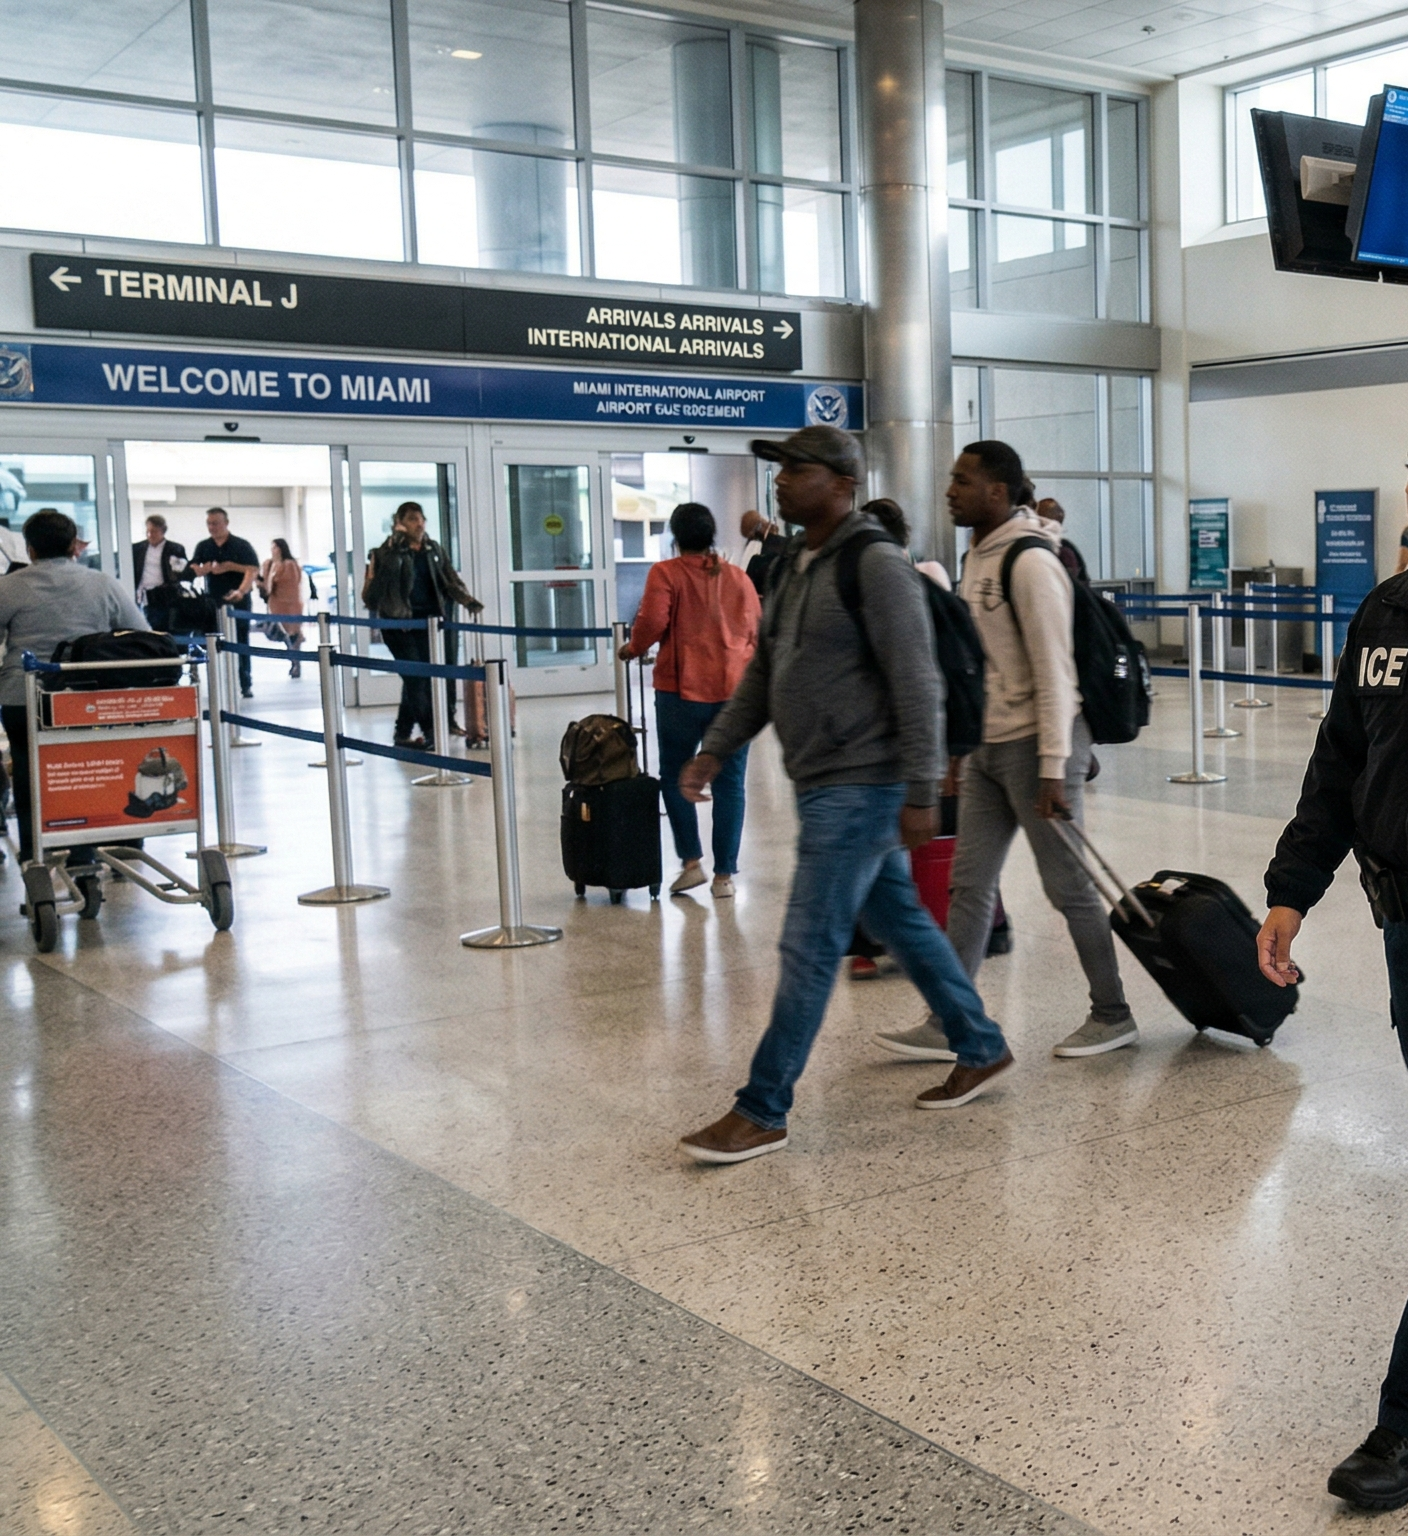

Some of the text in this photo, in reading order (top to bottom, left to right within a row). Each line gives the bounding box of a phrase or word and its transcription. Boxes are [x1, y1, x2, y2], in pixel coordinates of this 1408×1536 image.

[96, 268, 298, 309] TERMINAL J
[586, 307, 764, 336] ARRIVALS ARRIVALS
[528, 328, 764, 359] INTERNATIONAL ARRIVALS
[102, 363, 431, 403] WELCOME TO MIAMI
[573, 381, 766, 402] MIAMI INTERNATIONAL AIRPORT
[596, 401, 652, 415] AIRPORT
[1358, 647, 1408, 687] ICE
